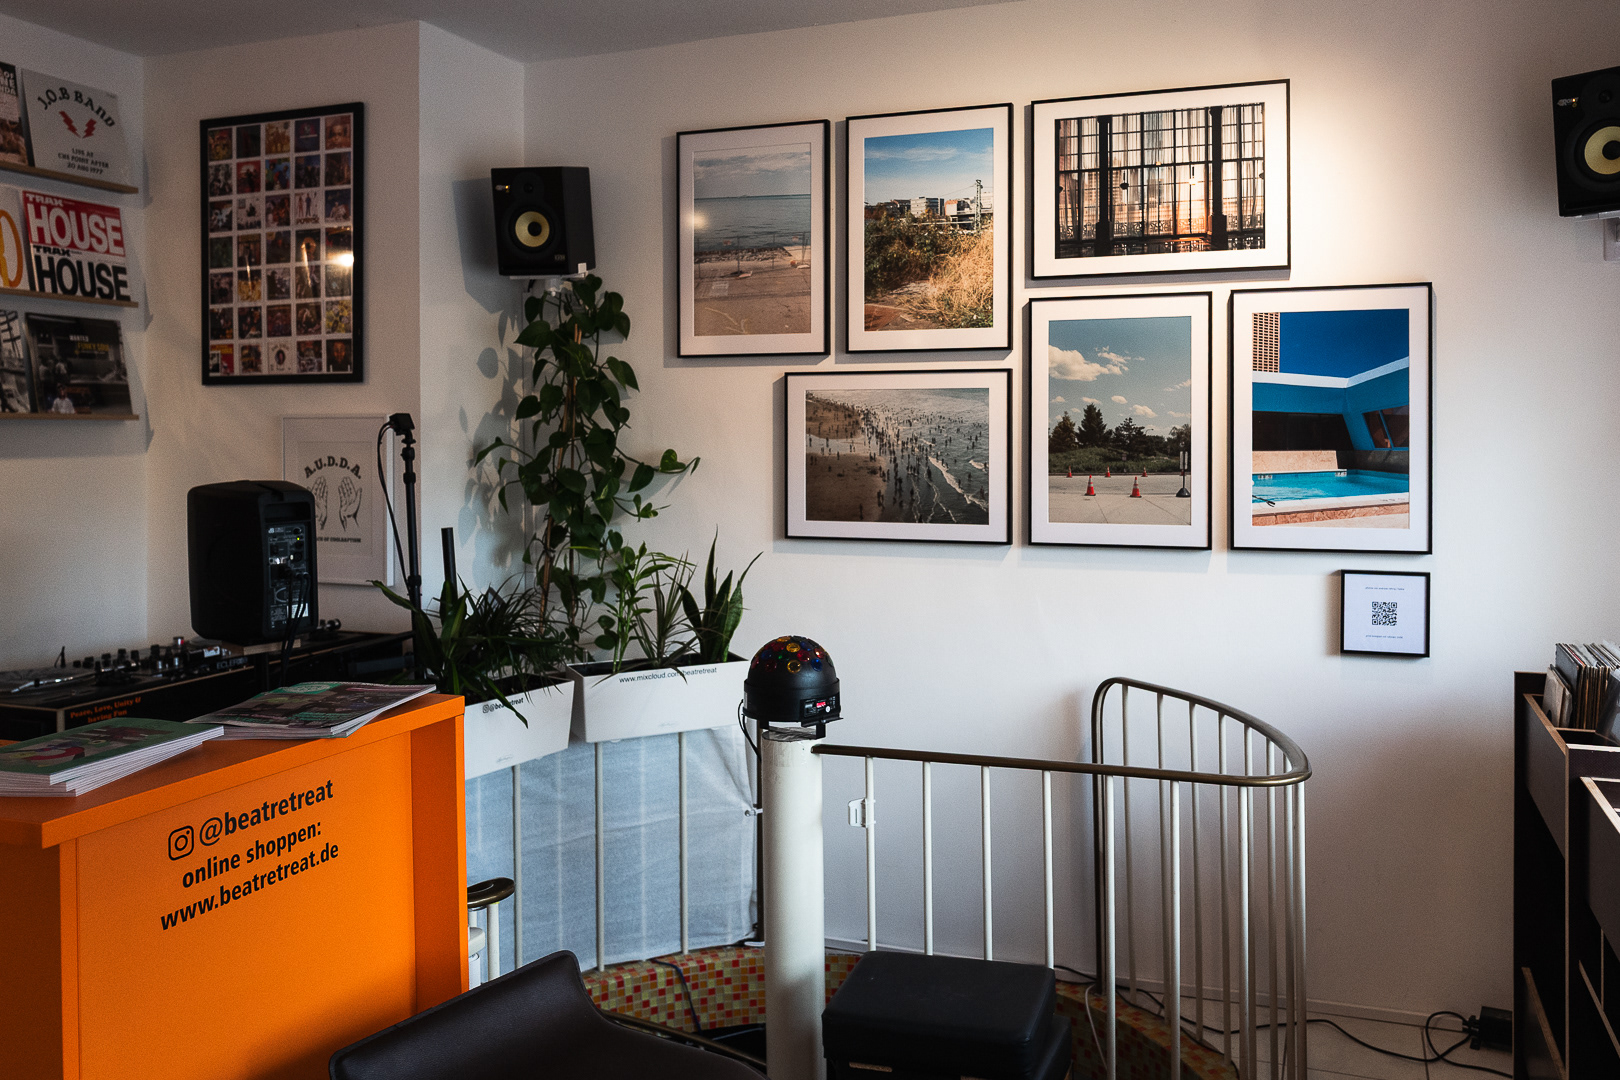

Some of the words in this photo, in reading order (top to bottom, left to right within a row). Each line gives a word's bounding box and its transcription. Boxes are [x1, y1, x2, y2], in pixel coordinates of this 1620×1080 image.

[25, 193, 64, 207] TRAX
[27, 203, 125, 256] HOUSE
[33, 245, 71, 258] TRAX
[34, 255, 131, 301] HOUSE
[304, 456, 362, 479] A.U.D.D.A.
[70, 709, 93, 719] Peace,
[114, 698, 133, 708] Unity
[113, 709, 128, 717] Fun
[199, 779, 334, 847] @beatretreat
[182, 853, 240, 888] online
[246, 821, 321, 864] shoppen:
[160, 842, 339, 931] www.beatretreat.de
